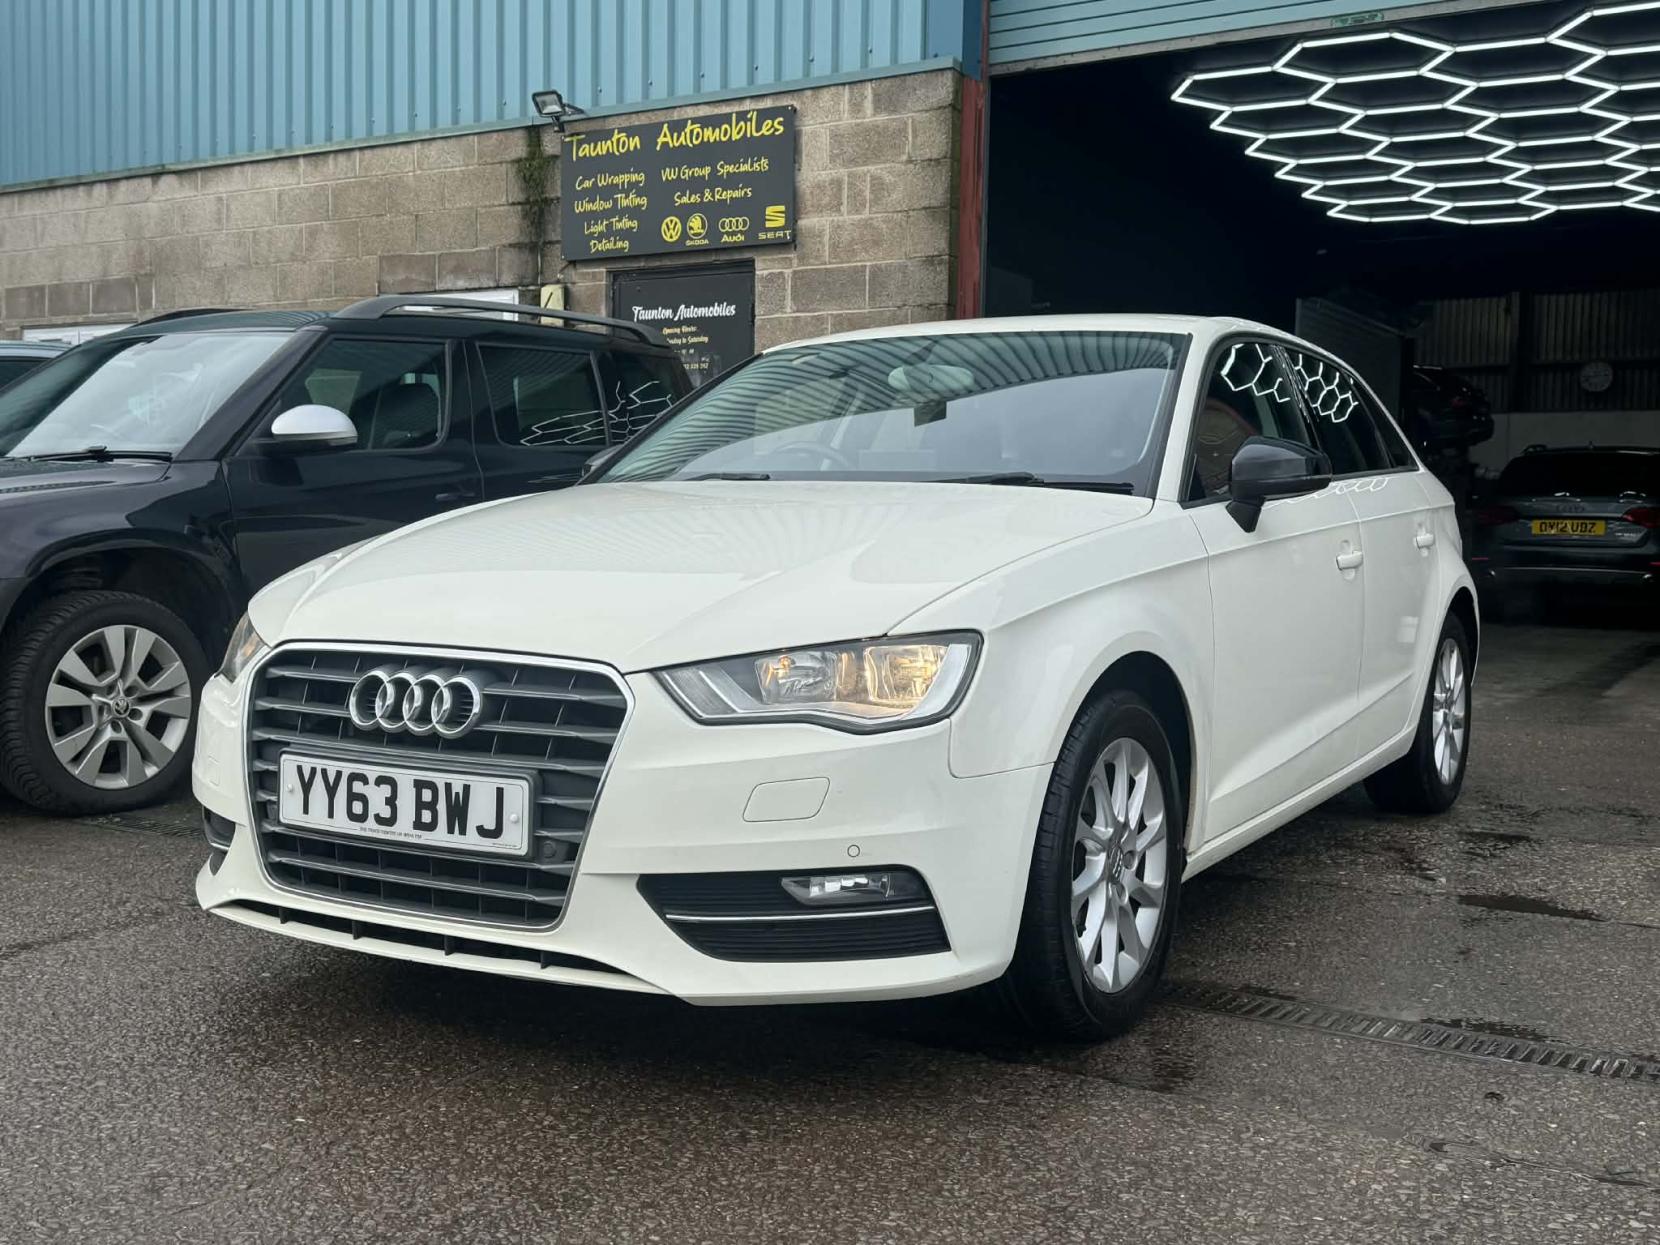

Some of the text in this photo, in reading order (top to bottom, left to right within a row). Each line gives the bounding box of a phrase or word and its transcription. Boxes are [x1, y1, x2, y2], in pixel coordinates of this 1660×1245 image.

[564, 110, 785, 161] Taunton Automobiles
[575, 168, 646, 190] Car Wrapping
[661, 156, 769, 182] VW Group Specialists
[574, 190, 648, 213] Window Tinting
[673, 184, 752, 207] Sales & Repairs
[584, 214, 639, 237] Light Tinting
[758, 230, 792, 240] SEAT
[590, 236, 630, 254] Detailing
[720, 233, 745, 243] Audi
[632, 301, 736, 322] Taunton Automobiles
[296, 764, 504, 840] YY63 BWJ
